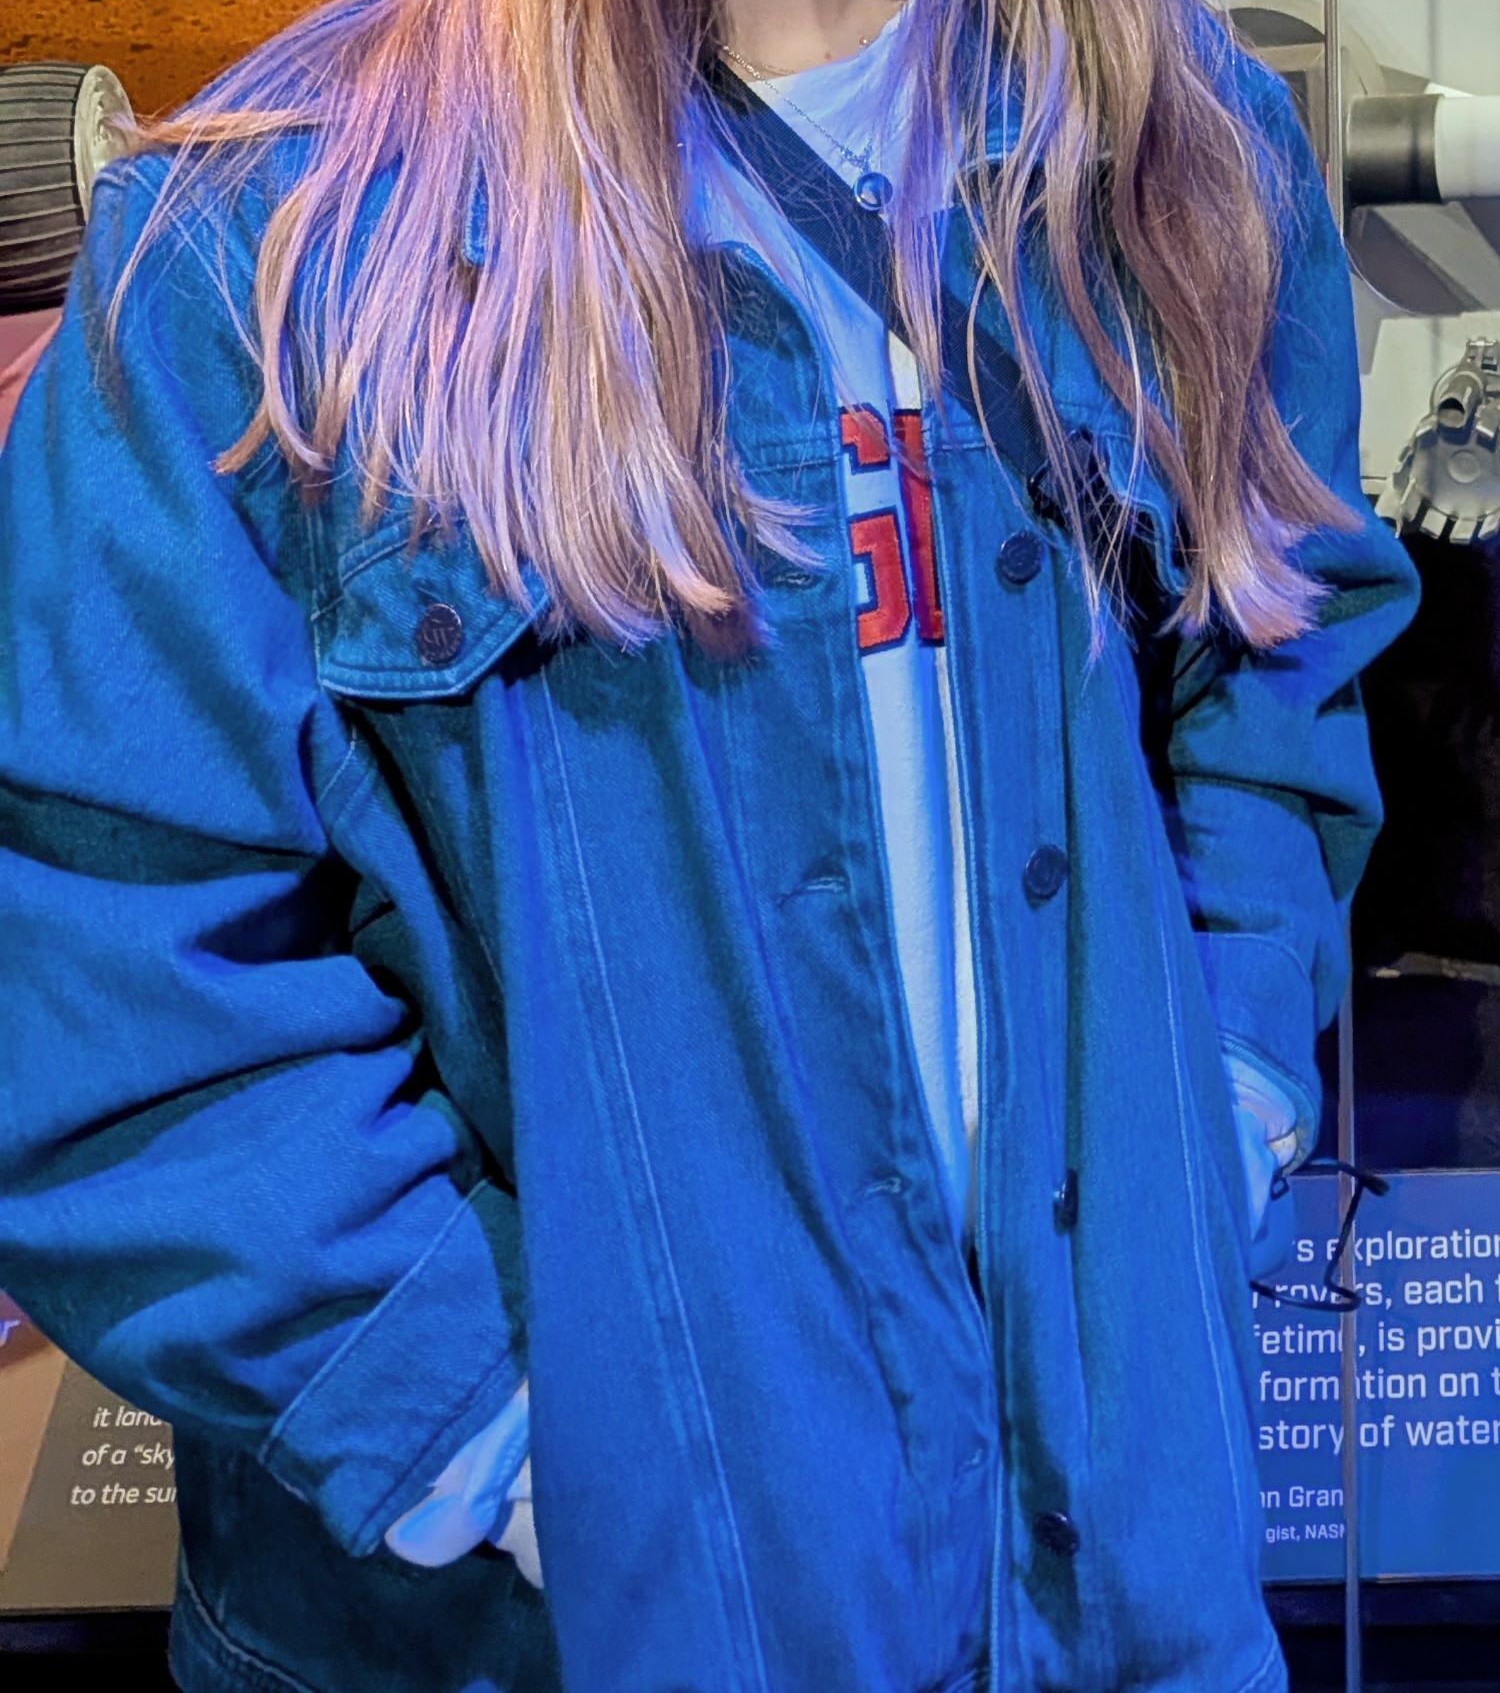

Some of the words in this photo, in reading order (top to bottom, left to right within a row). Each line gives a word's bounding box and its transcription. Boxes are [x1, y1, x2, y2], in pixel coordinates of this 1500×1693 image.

[1404, 1272, 1484, 1305] each
[1254, 1323, 1366, 1357] etim,
[1377, 1321, 1405, 1352] is
[1259, 1367, 1426, 1402] formtion
[1439, 1371, 1480, 1398] on
[92, 1406, 111, 1428] it
[1259, 1420, 1345, 1455] story
[1359, 1414, 1395, 1448] of
[82, 1443, 111, 1466] of
[111, 1450, 127, 1465] a
[70, 1485, 96, 1505] to
[101, 1483, 140, 1505] the
